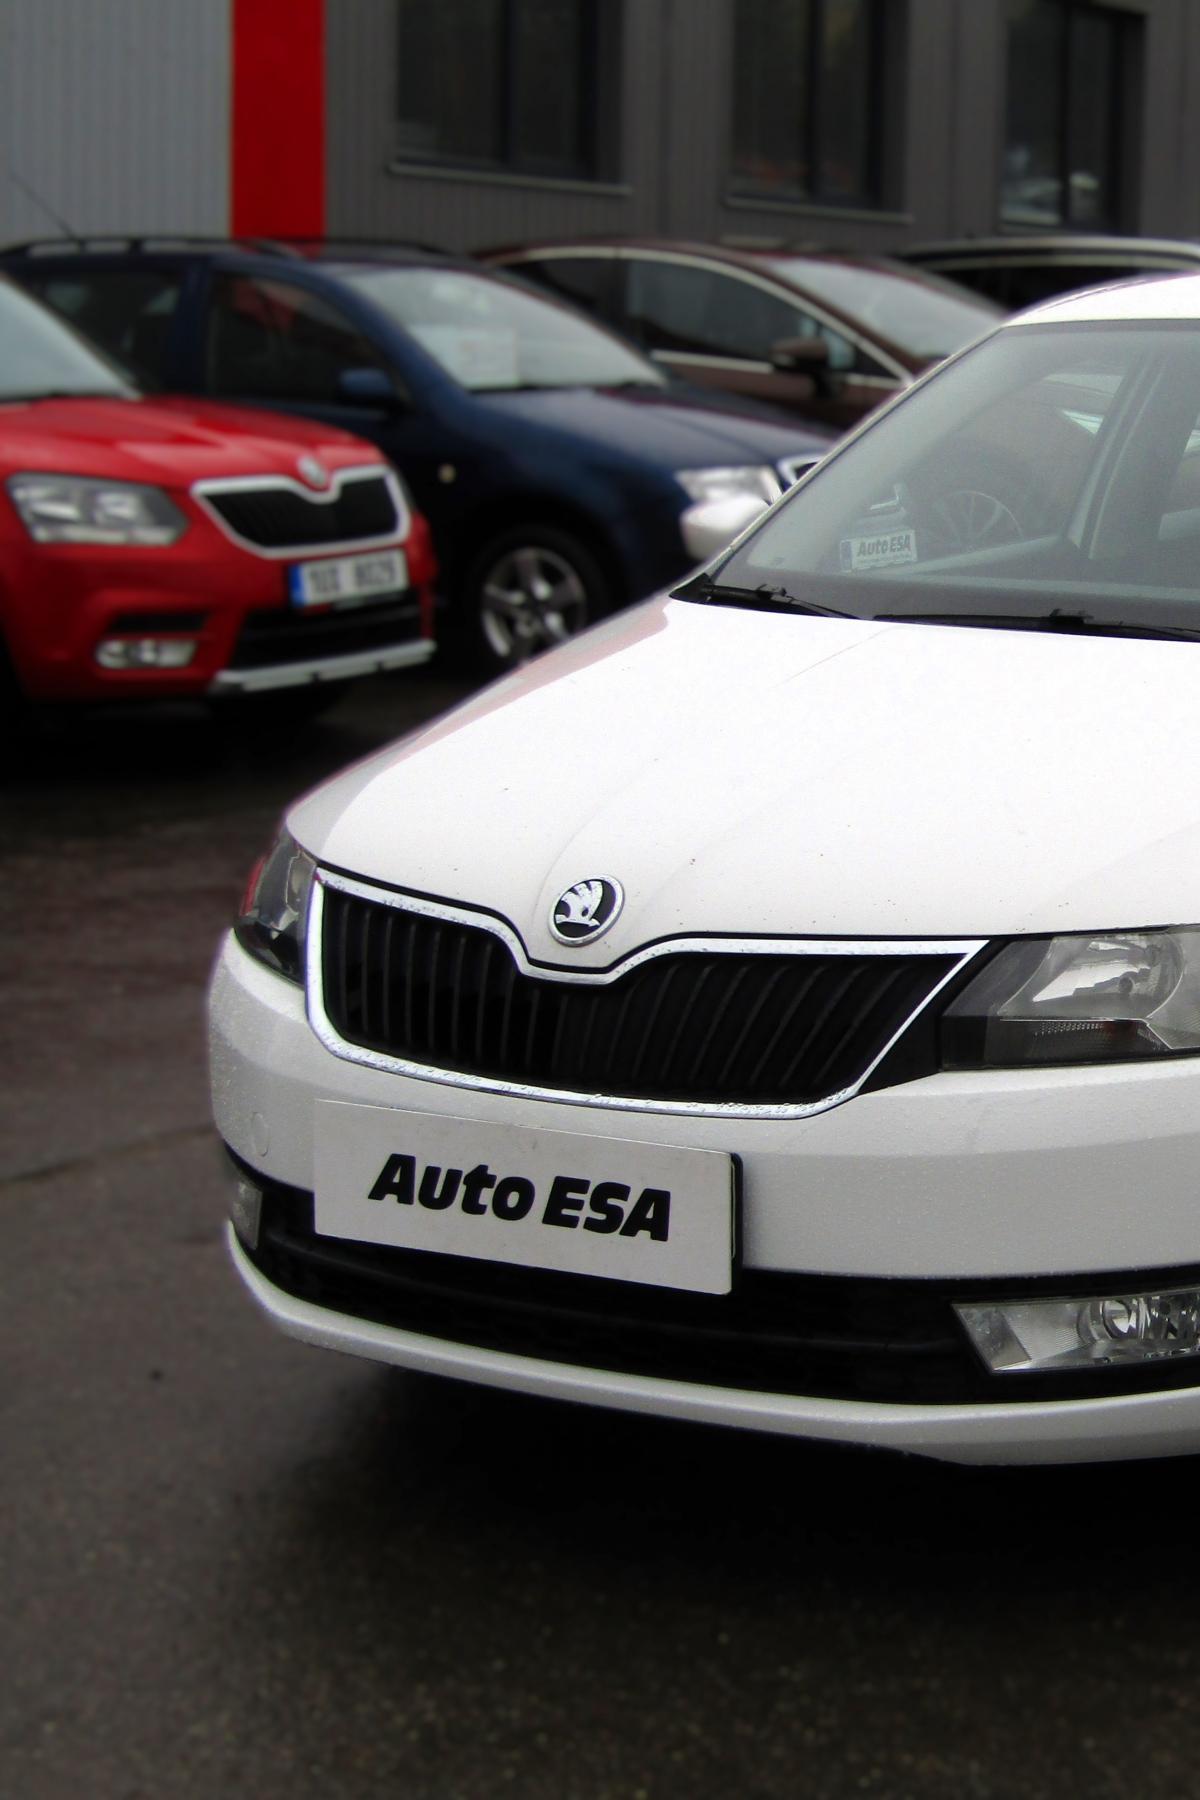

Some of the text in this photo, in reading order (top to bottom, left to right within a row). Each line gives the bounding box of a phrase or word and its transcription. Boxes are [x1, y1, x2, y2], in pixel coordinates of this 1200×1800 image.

[856, 534, 912, 557] Auto ESA
[367, 1152, 672, 1243] Auto ESA
